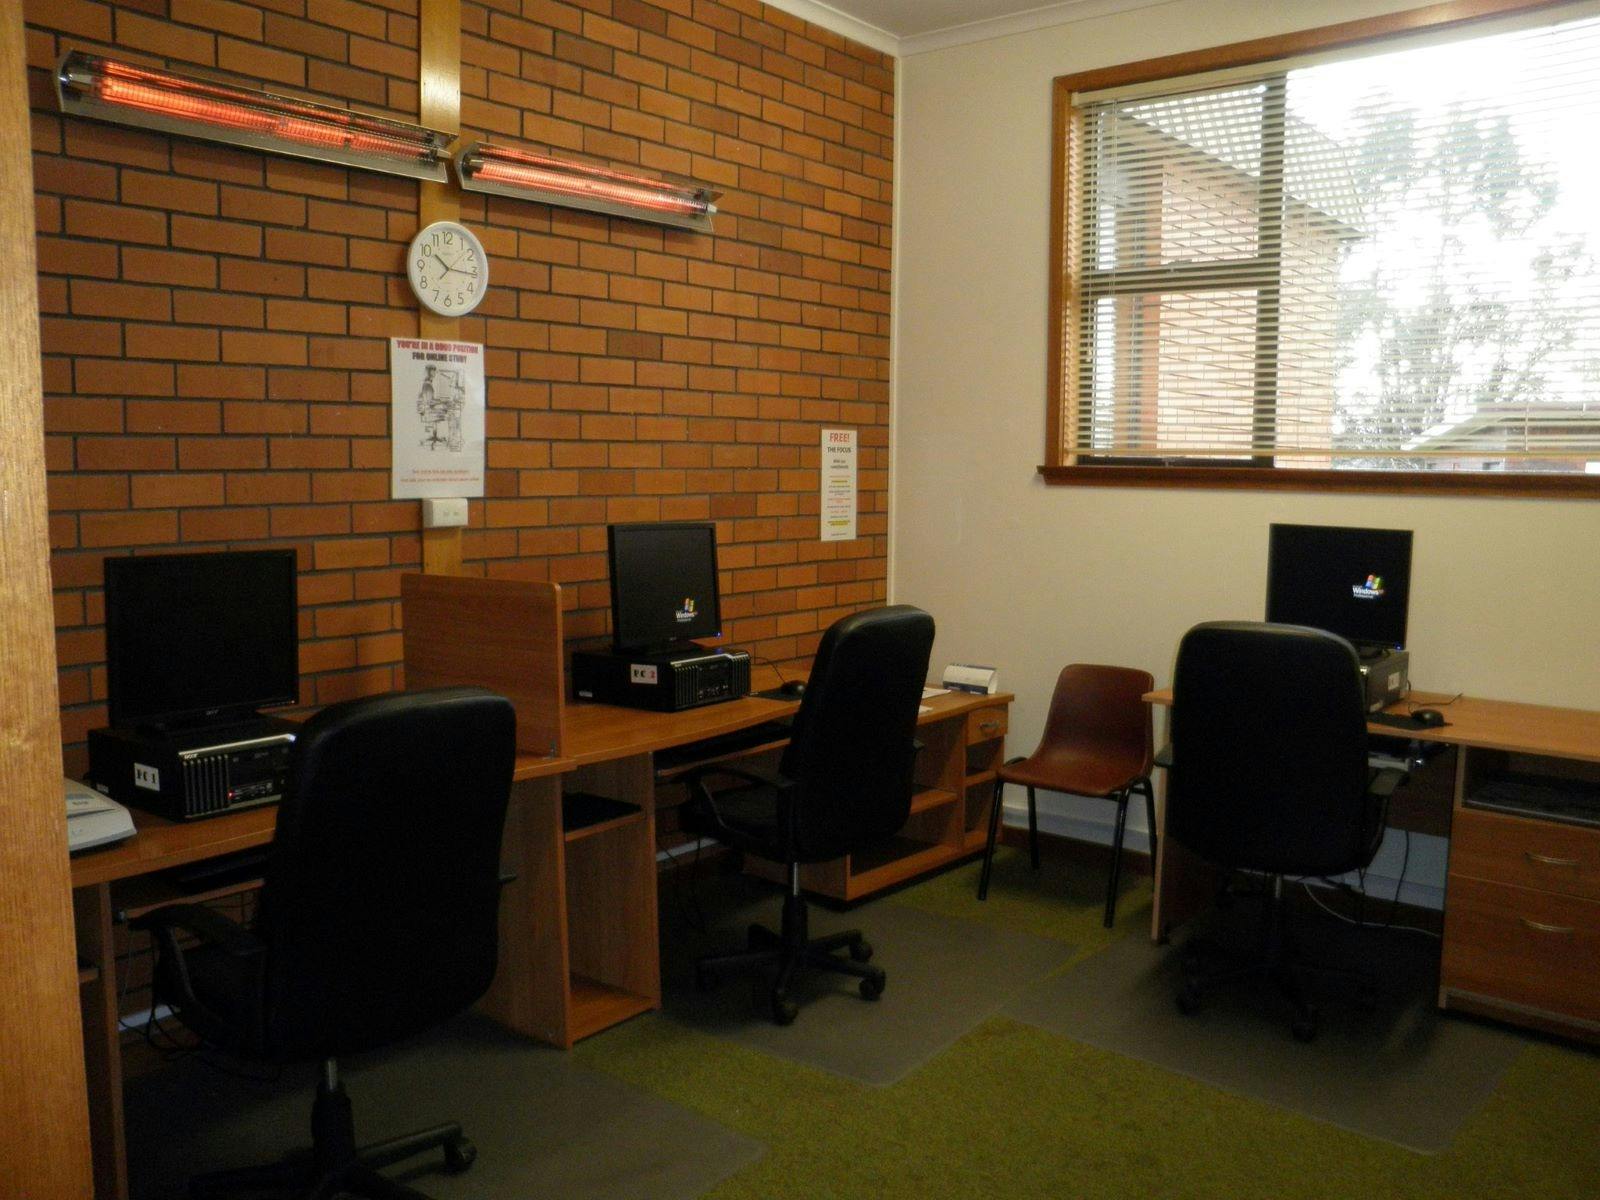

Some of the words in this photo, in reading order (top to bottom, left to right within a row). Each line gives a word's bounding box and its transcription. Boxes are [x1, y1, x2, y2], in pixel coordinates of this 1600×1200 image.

[432, 233, 440, 247] 11
[442, 231, 453, 246] 12
[460, 237, 464, 251] 1
[420, 243, 432, 258] 10
[466, 248, 475, 262] 2
[416, 259, 425, 273] 9
[470, 266, 479, 279] 3
[419, 275, 428, 289] 8
[466, 281, 475, 295] 4
[432, 289, 440, 303] 7
[443, 294, 453, 308] 6
[456, 291, 465, 306] 5
[429, 341, 434, 350] A
[412, 351, 425, 361] FOR
[426, 353, 447, 362] ONLINE
[829, 432, 850, 443] FREE!
[837, 446, 852, 454] FOCUS
[1352, 587, 1379, 596] Windows
[634, 669, 647, 679] PC
[650, 671, 656, 679] 2
[136, 768, 148, 782] PC
[151, 773, 156, 785] 1
